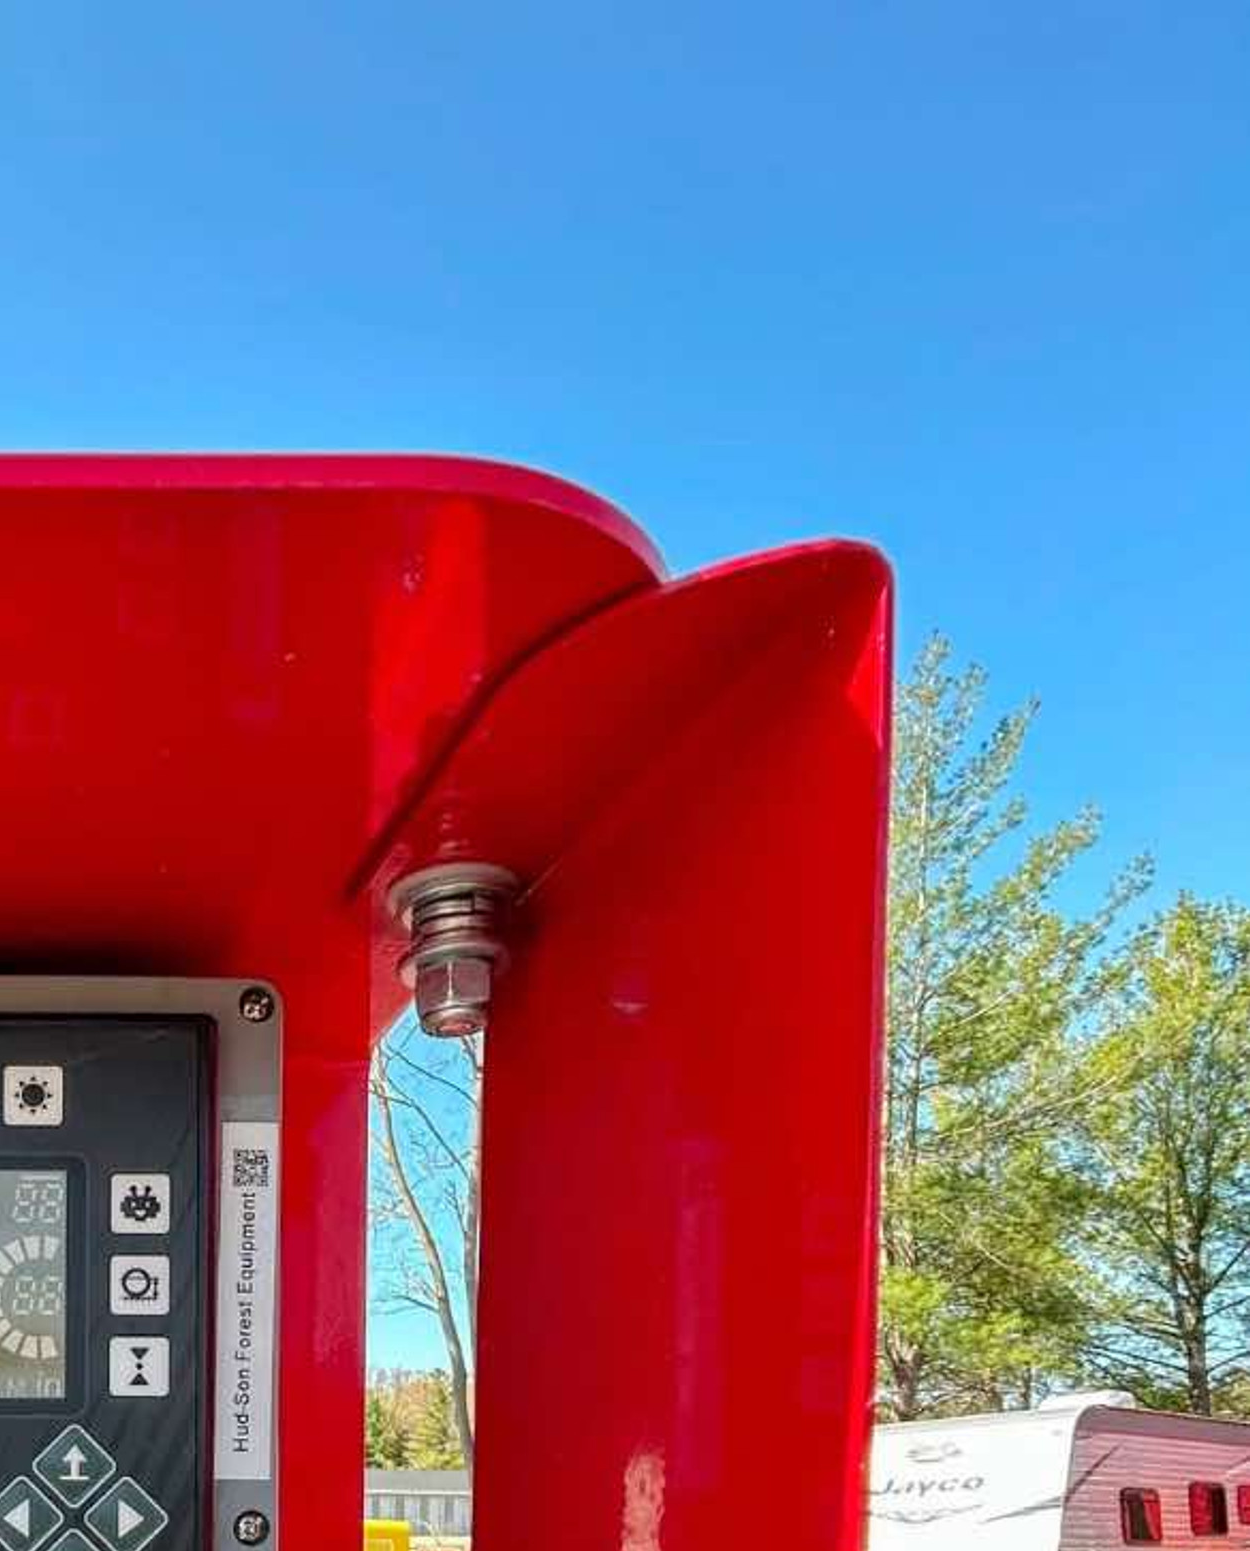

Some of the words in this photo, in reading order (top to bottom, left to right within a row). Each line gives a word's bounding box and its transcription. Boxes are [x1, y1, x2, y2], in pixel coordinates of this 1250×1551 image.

[236, 1192, 258, 1294] Equipment
[234, 1301, 254, 1362] Forest
[232, 1369, 251, 1453] Hud-Son
